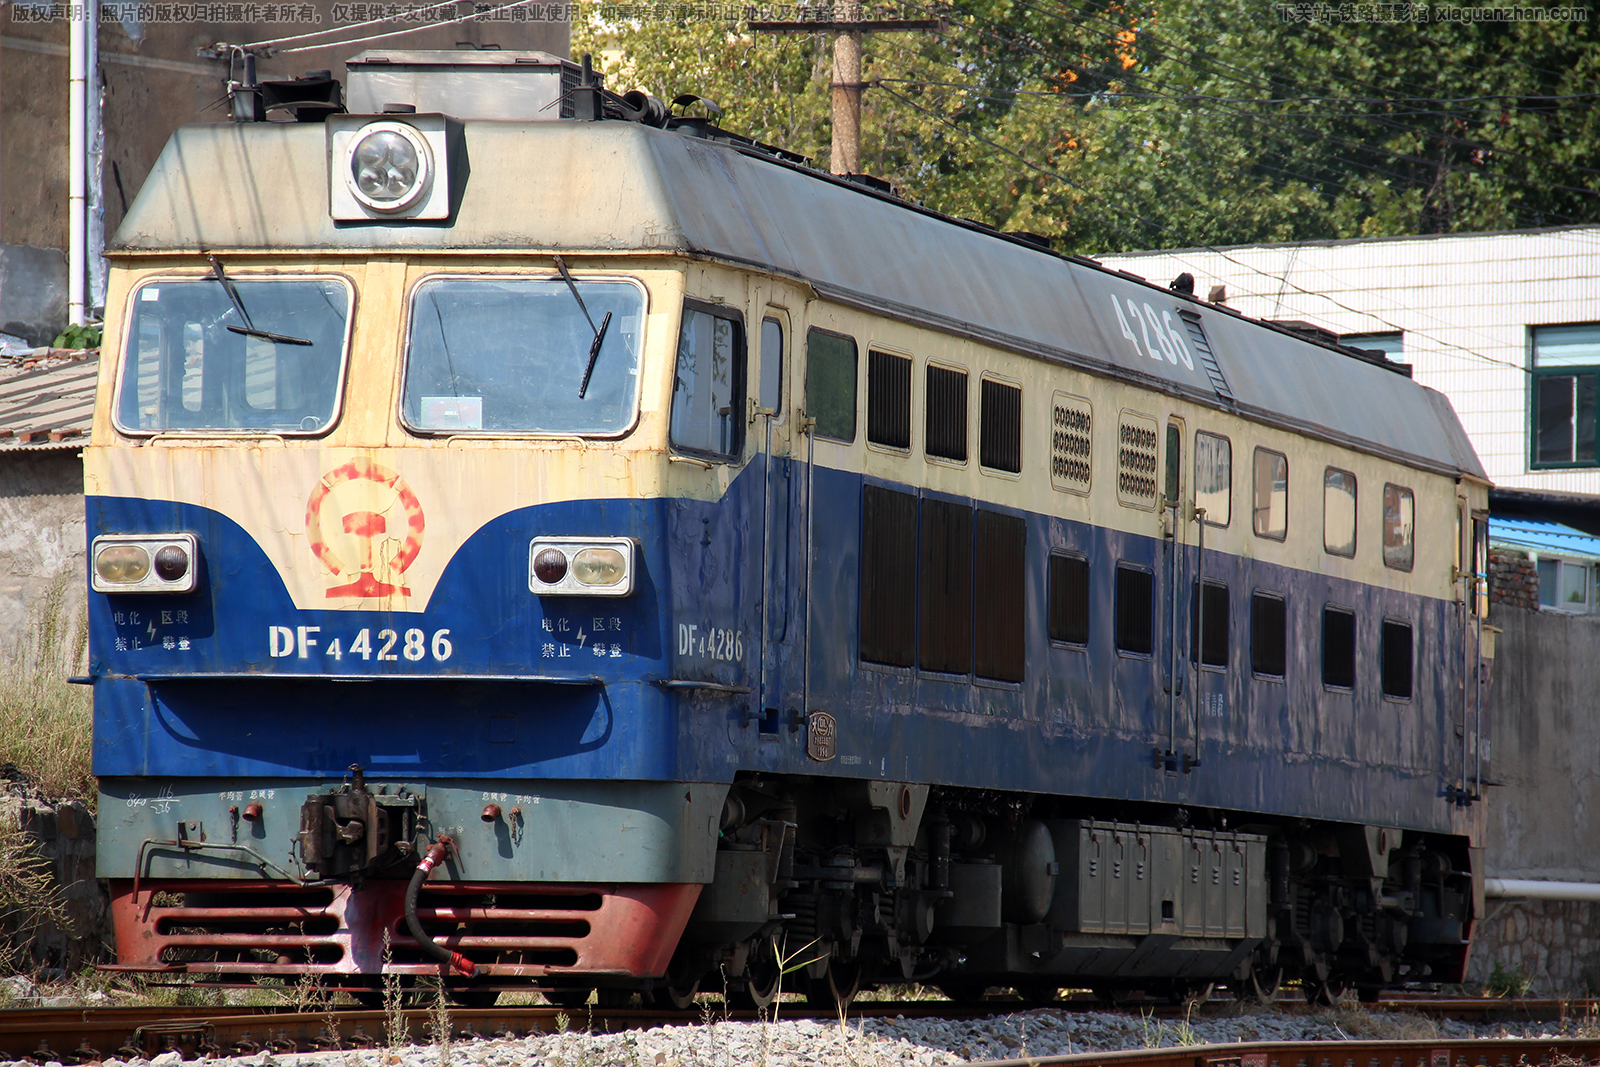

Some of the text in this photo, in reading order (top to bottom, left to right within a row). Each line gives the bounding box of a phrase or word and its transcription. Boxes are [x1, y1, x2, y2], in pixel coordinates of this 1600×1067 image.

[1110, 293, 1195, 372] 4286
[113, 609, 189, 626] 电化 区段
[541, 616, 622, 632] 电化 区段
[114, 636, 143, 652] 禁止
[541, 642, 571, 658] 禁止
